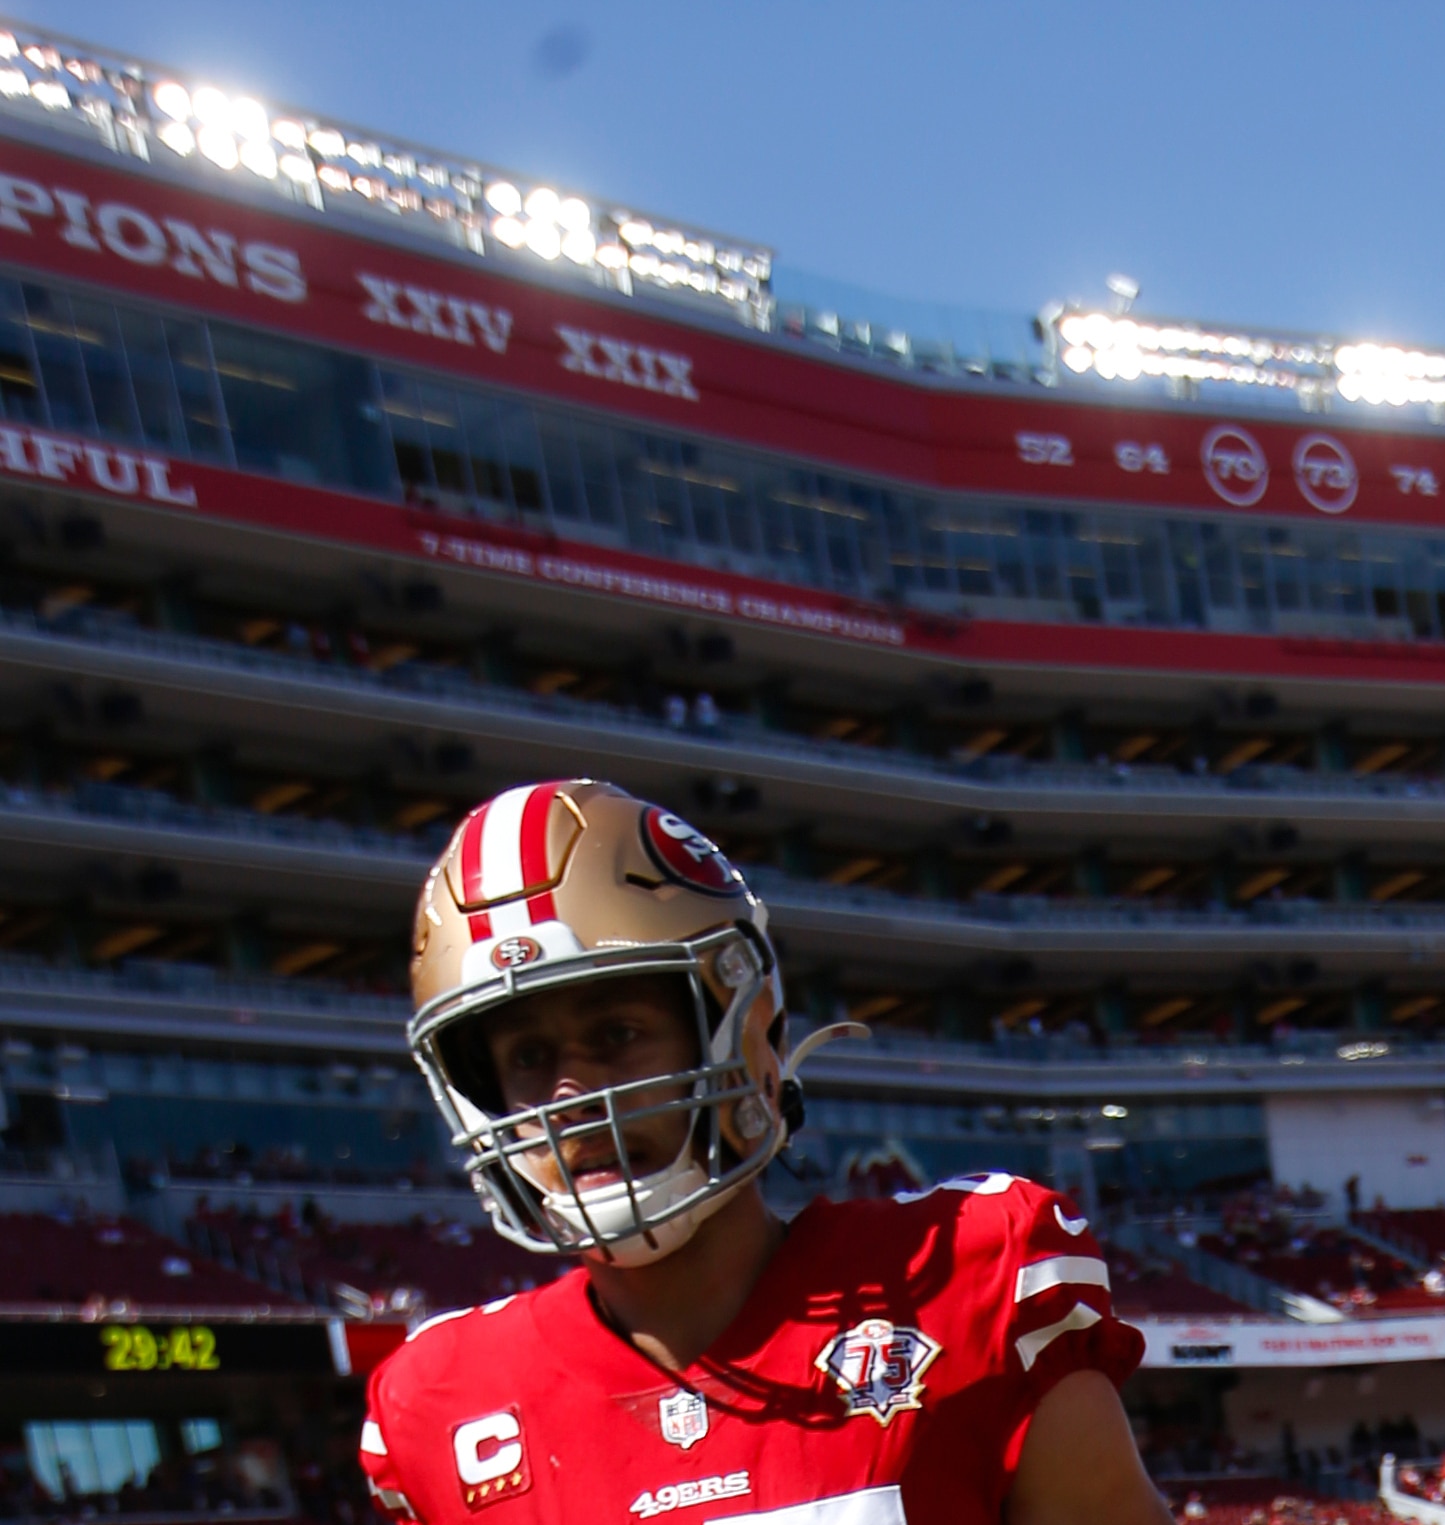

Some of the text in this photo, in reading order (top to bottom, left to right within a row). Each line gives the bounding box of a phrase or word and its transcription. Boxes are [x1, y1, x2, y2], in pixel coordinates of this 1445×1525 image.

[355, 272, 513, 355] XXIV
[556, 323, 699, 402] XXIX
[100, 1326, 219, 1370] 29:42
[845, 1341, 909, 1389] 75
[453, 1411, 523, 1485] C
[629, 1469, 752, 1519] 49ERS
